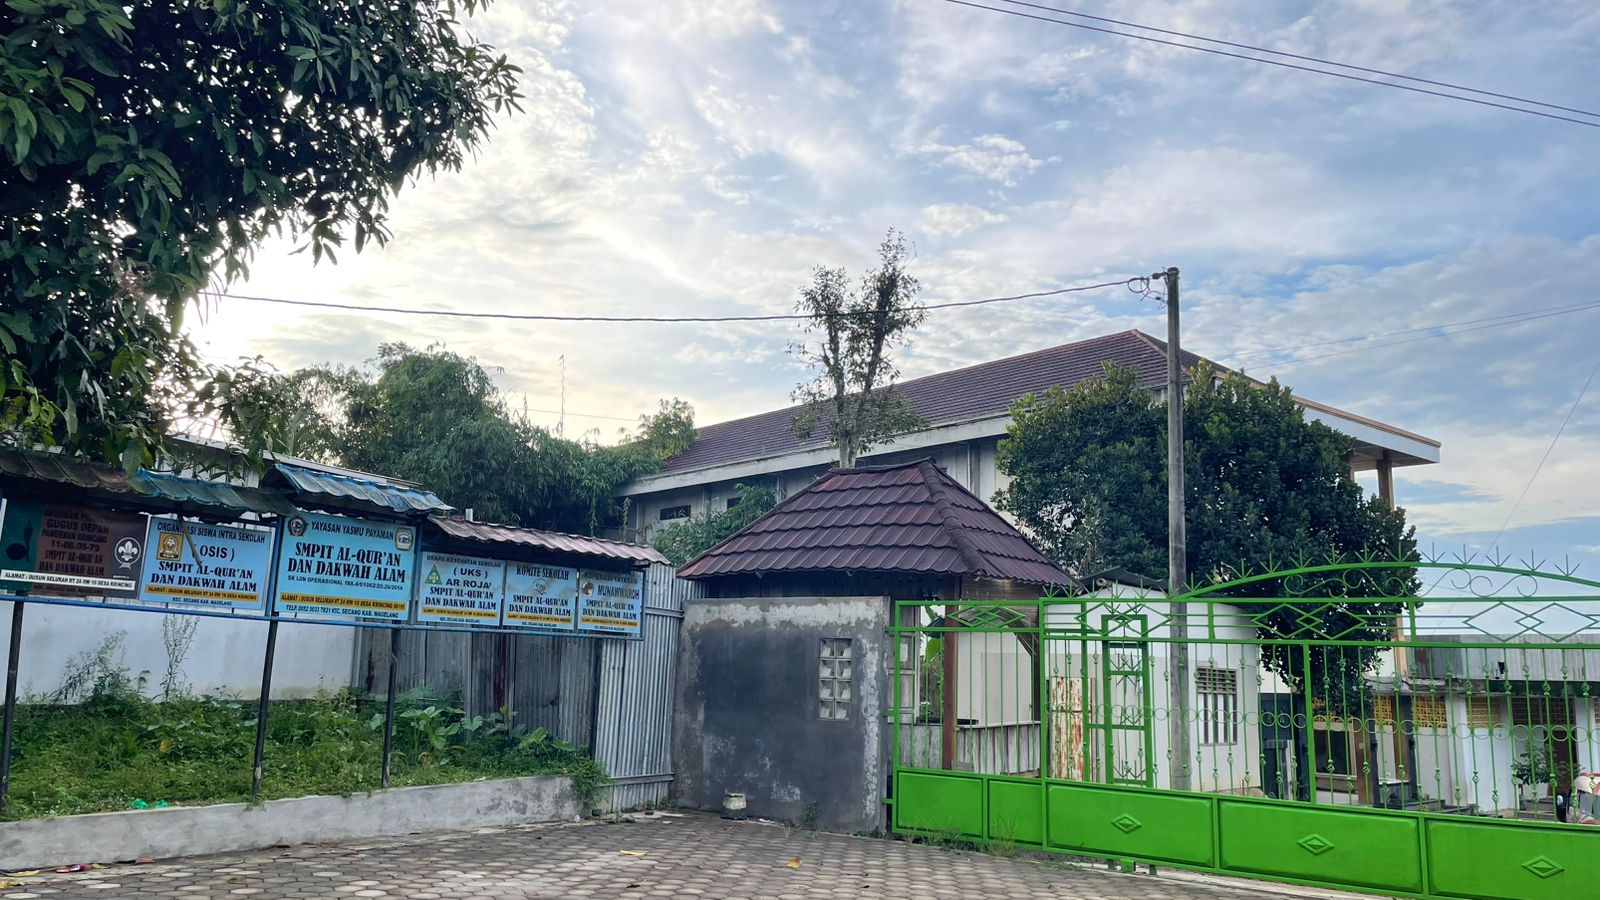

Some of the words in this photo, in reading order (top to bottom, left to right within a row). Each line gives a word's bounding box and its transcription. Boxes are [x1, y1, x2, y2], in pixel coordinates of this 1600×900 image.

[47, 519, 78, 531] GUGUS
[81, 522, 108, 534] DEPAN
[311, 520, 341, 532] YAYASAN
[342, 524, 363, 536] YASMU
[366, 528, 394, 540] PAYAMAN
[198, 527, 216, 538] SISWA
[218, 530, 236, 540] INTRA
[238, 532, 266, 544] SEKOLAH
[200, 544, 228, 558] OSIS
[296, 542, 334, 560] SMPIT
[337, 546, 401, 567] AL-QUR'AN
[39, 561, 54, 571] DAN
[86, 565, 105, 576] ALAM
[159, 560, 194, 574] SMPIT
[196, 565, 253, 580] AL-QUR'AN
[288, 558, 312, 573] DAN
[316, 560, 371, 580] DAKWAH
[374, 568, 406, 583] ALAM
[460, 568, 481, 577] UKS
[516, 565, 540, 577] KOMITE
[542, 568, 569, 580] SEKOLAH
[150, 573, 174, 584] DAN
[178, 576, 225, 590] DAKWAH
[228, 580, 257, 592] ALAM
[308, 576, 344, 585] OPERASIONAL
[446, 578, 460, 586] AR
[430, 586, 453, 596] SMPIT
[455, 588, 494, 600] AL-QUR'AN
[513, 594, 533, 603] SMPIT
[536, 596, 568, 606] AL-QUR'AN
[425, 597, 441, 605] DAN
[443, 598, 475, 608] DAKWAH
[478, 602, 496, 610] ALAM
[509, 604, 523, 612] DAN
[525, 606, 553, 615] DAKWAH
[555, 608, 571, 616] ALAM
[596, 609, 620, 618] DAKWAH
[623, 612, 637, 620] ALAM
